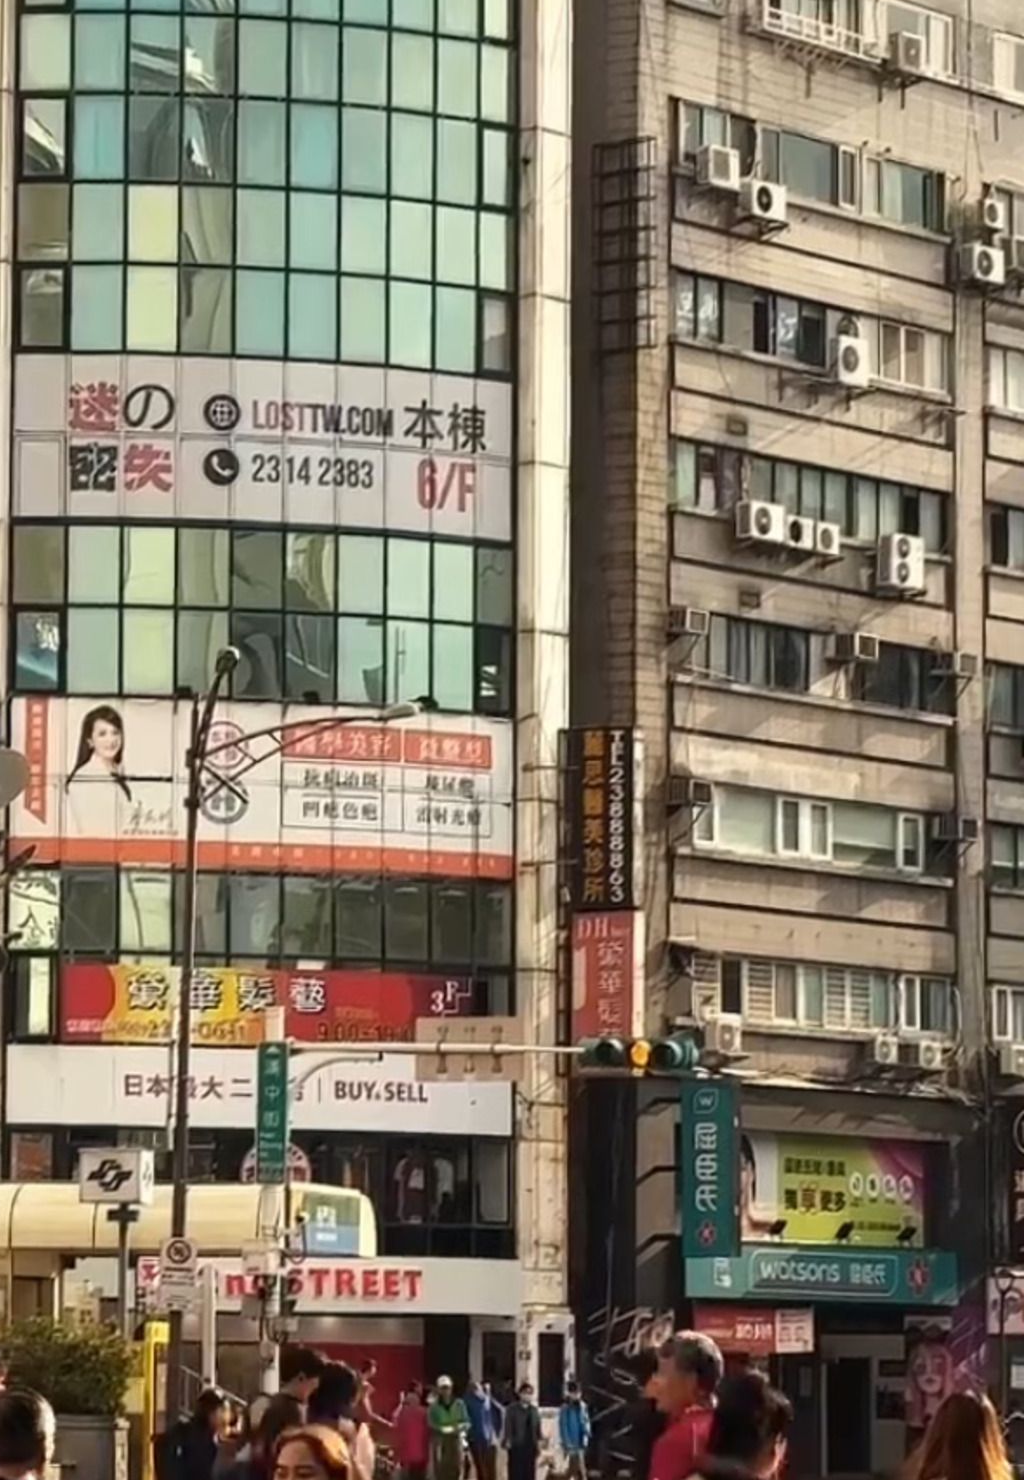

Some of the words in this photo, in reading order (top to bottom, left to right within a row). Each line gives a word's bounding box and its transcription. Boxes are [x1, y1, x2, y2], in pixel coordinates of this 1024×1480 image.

[251, 399, 394, 437] LOSTTW.COM
[403, 398, 488, 454] 本棟
[251, 453, 311, 486] 2314
[318, 456, 374, 489] 2383
[416, 458, 478, 512] 6/F
[694, 1122, 718, 1212] 屈臣氏
[286, 1267, 423, 1300] STREET
[759, 1260, 841, 1284] watsons
